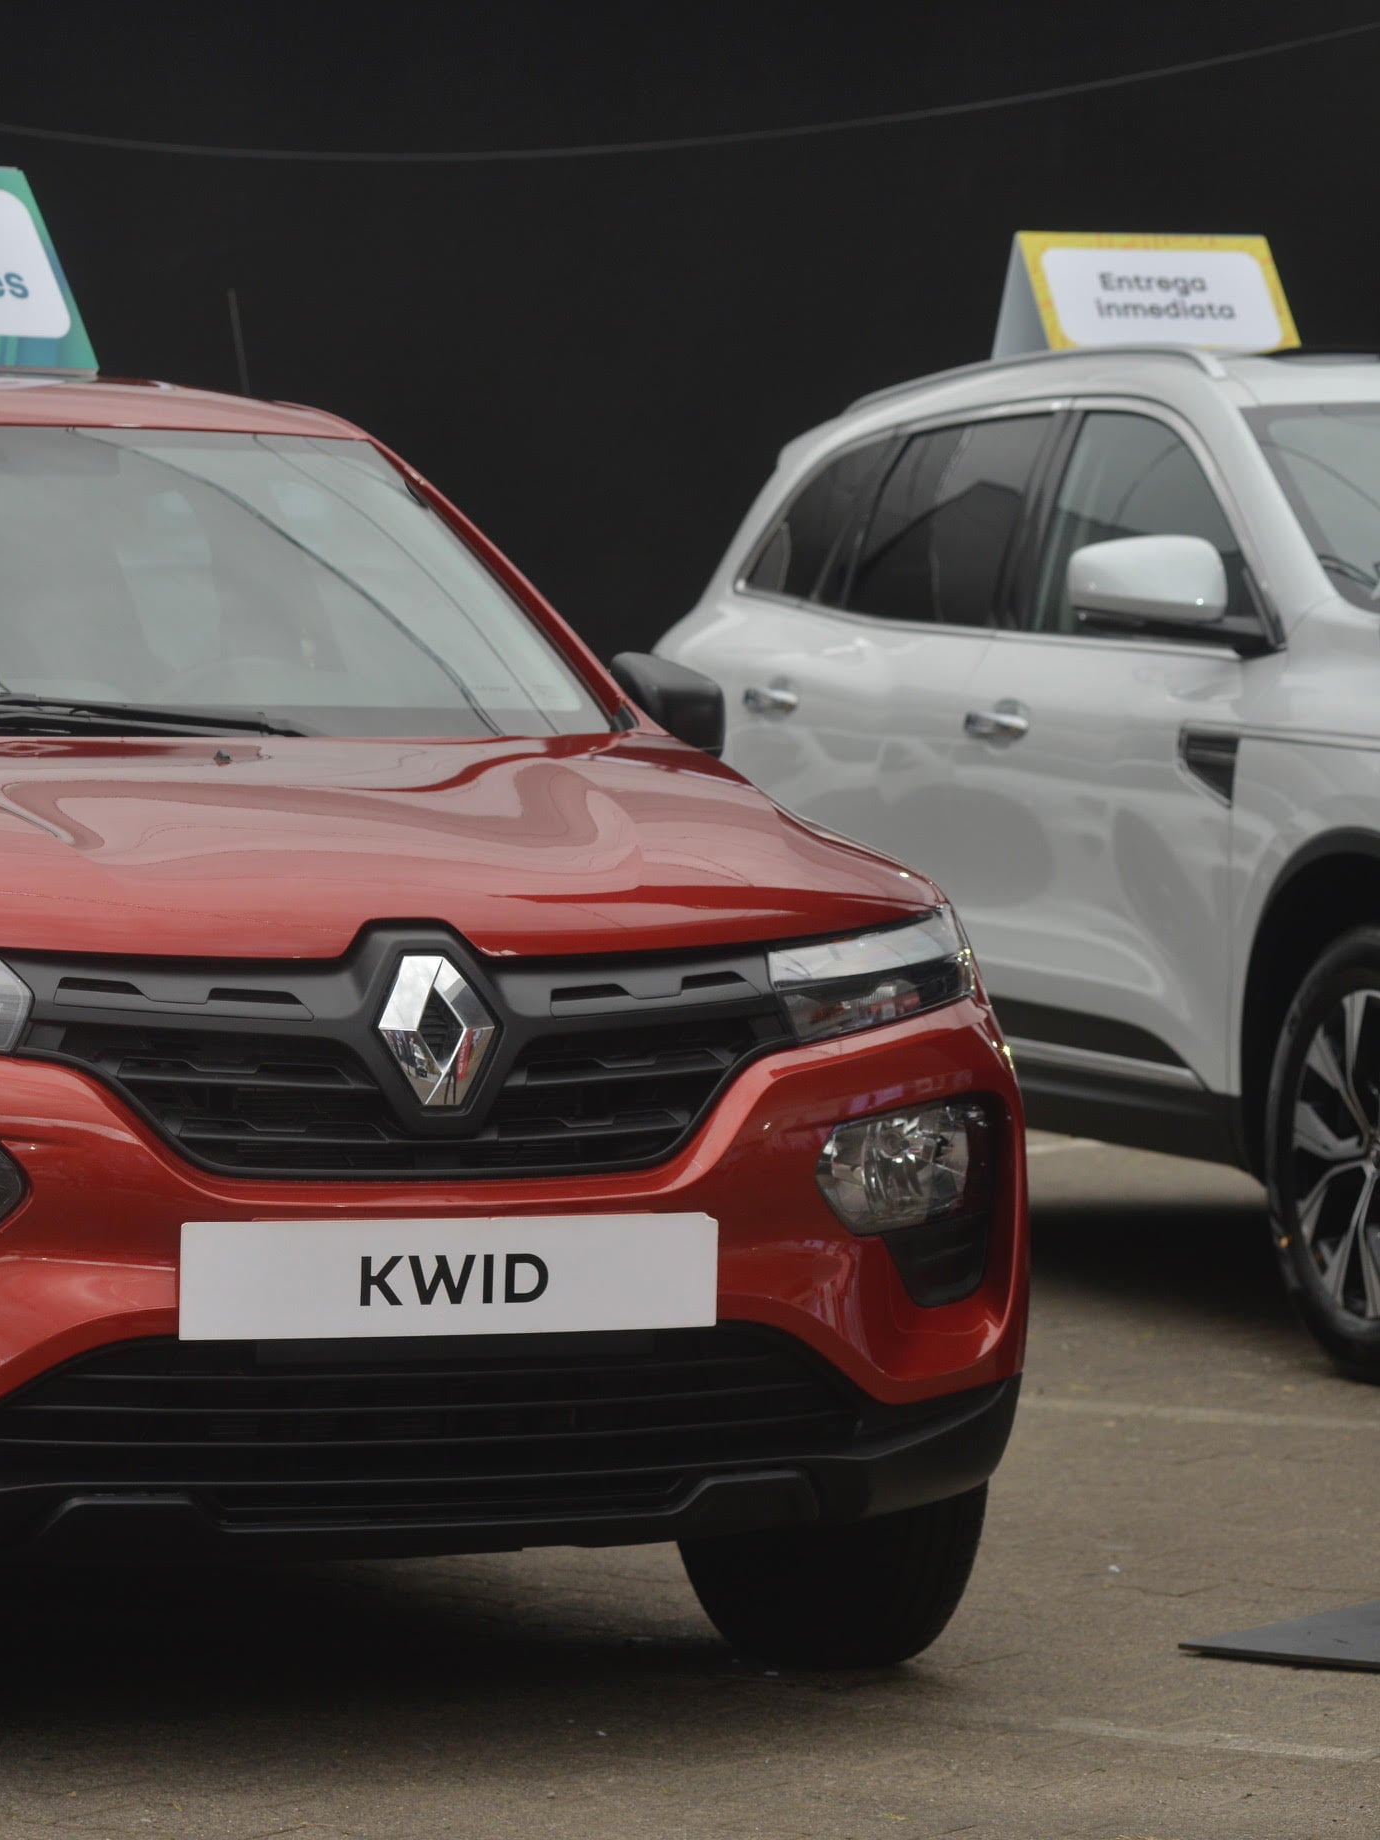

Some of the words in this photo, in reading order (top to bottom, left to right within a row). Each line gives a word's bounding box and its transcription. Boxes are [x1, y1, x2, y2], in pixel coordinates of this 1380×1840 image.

[1099, 272, 1207, 296] Entrega
[1095, 299, 1236, 320] inmediata
[360, 1253, 550, 1307] KWID
